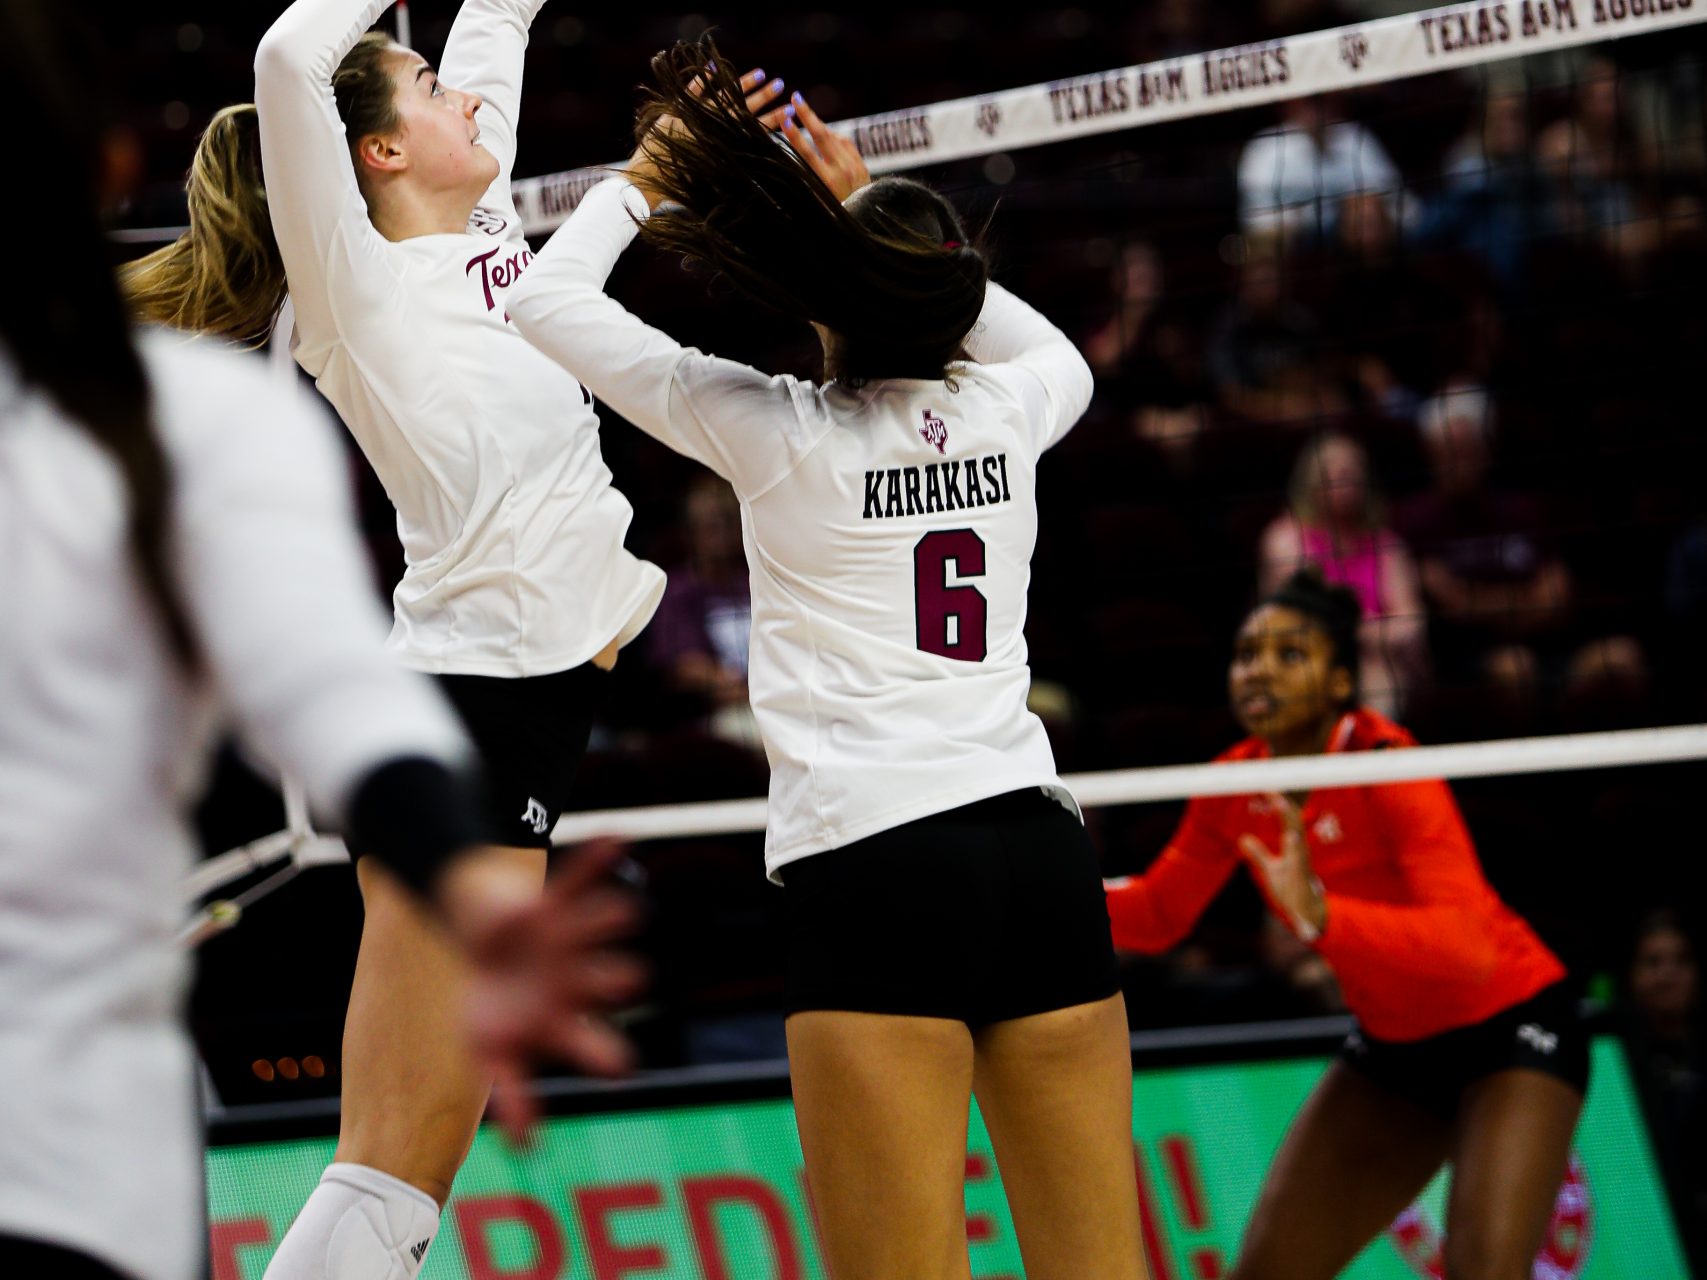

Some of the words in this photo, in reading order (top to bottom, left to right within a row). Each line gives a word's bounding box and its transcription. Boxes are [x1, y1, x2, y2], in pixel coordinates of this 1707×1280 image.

[1049, 77, 1131, 123] TEXAS
[1203, 46, 1290, 96] AGGIES
[1418, 4, 1510, 54] TEXAS
[863, 453, 1011, 519] KARAKASI
[913, 527, 988, 662] 6
